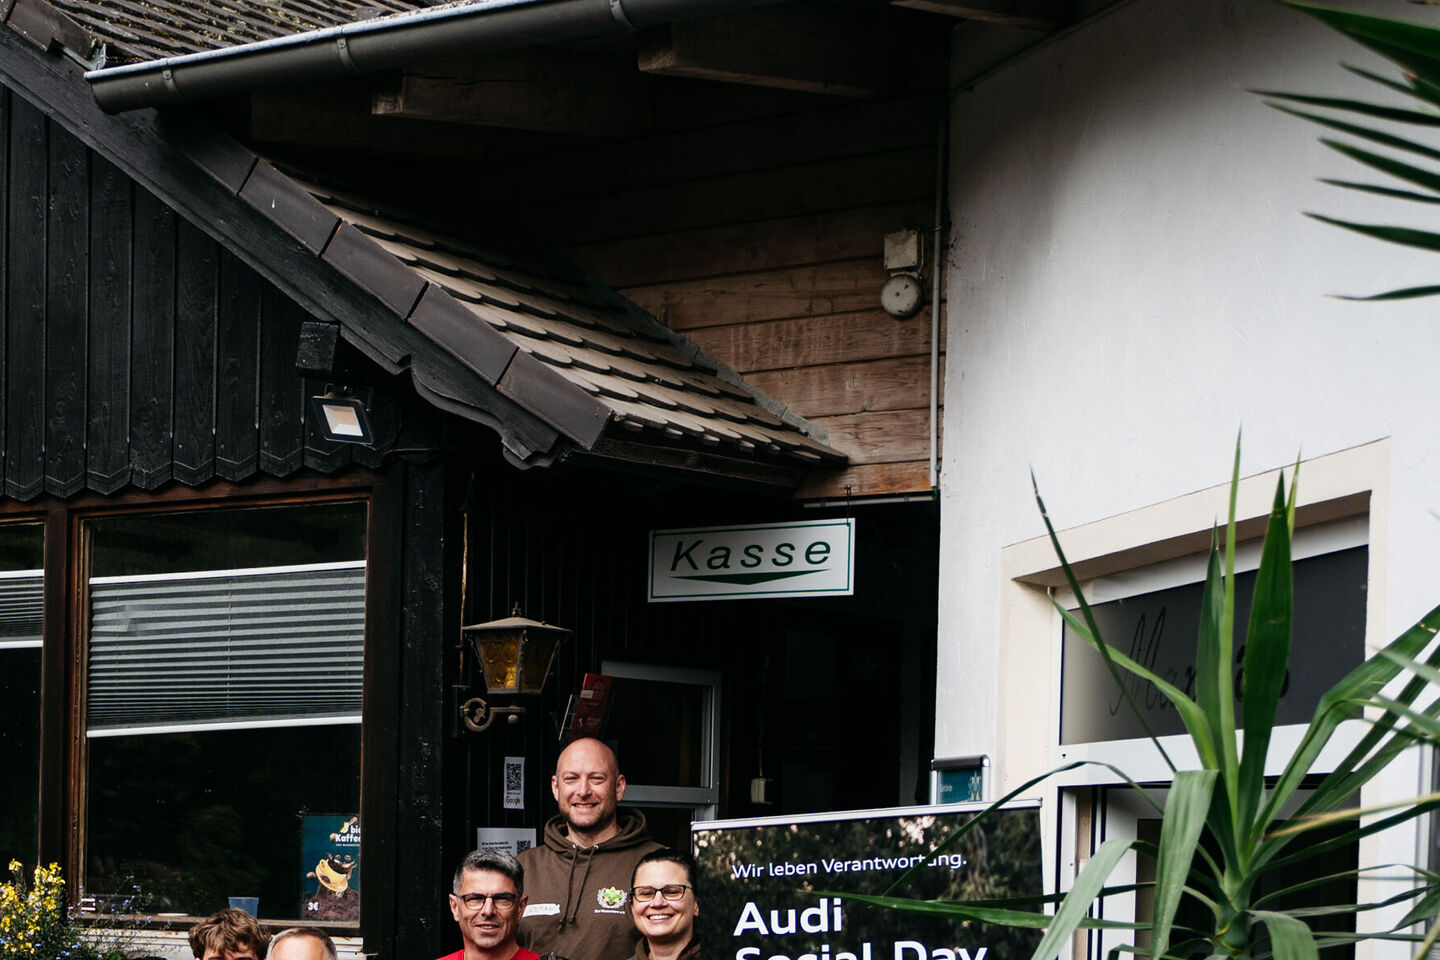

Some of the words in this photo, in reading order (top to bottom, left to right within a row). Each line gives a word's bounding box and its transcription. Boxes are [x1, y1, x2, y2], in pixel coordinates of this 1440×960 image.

[670, 540, 831, 571] Kasse
[732, 863, 764, 879] Wir
[769, 860, 818, 877] leben
[307, 901, 319, 911] 3€
[733, 897, 843, 937] Audi
